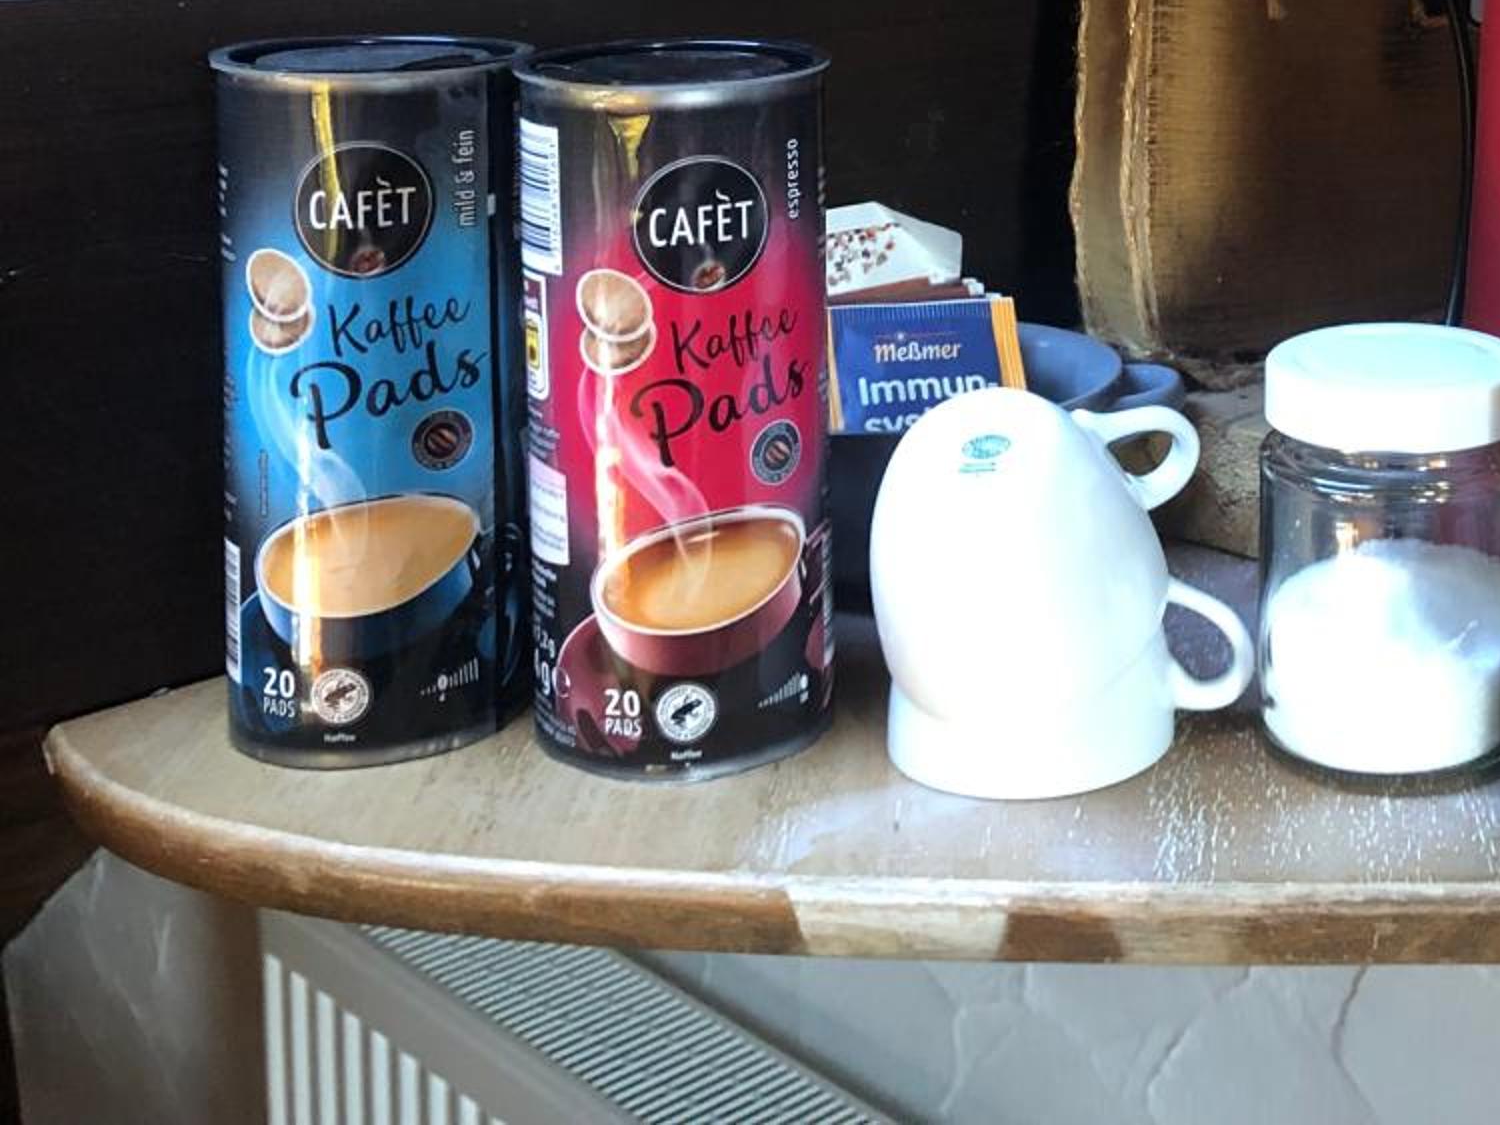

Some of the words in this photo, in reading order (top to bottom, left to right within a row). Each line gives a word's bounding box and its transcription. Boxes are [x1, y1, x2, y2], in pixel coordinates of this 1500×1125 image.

[453, 129, 475, 165] fein
[787, 138, 803, 220] espresso
[455, 190, 476, 228] mild
[328, 295, 472, 358] Kaffee
[670, 306, 799, 375] Kaffee
[872, 340, 962, 364] Meßmer
[289, 339, 489, 450] Pads
[629, 353, 813, 468] Pads
[262, 666, 296, 698] 20
[262, 696, 296, 718] PADS
[603, 687, 641, 718] 20
[604, 717, 643, 737] PADS
